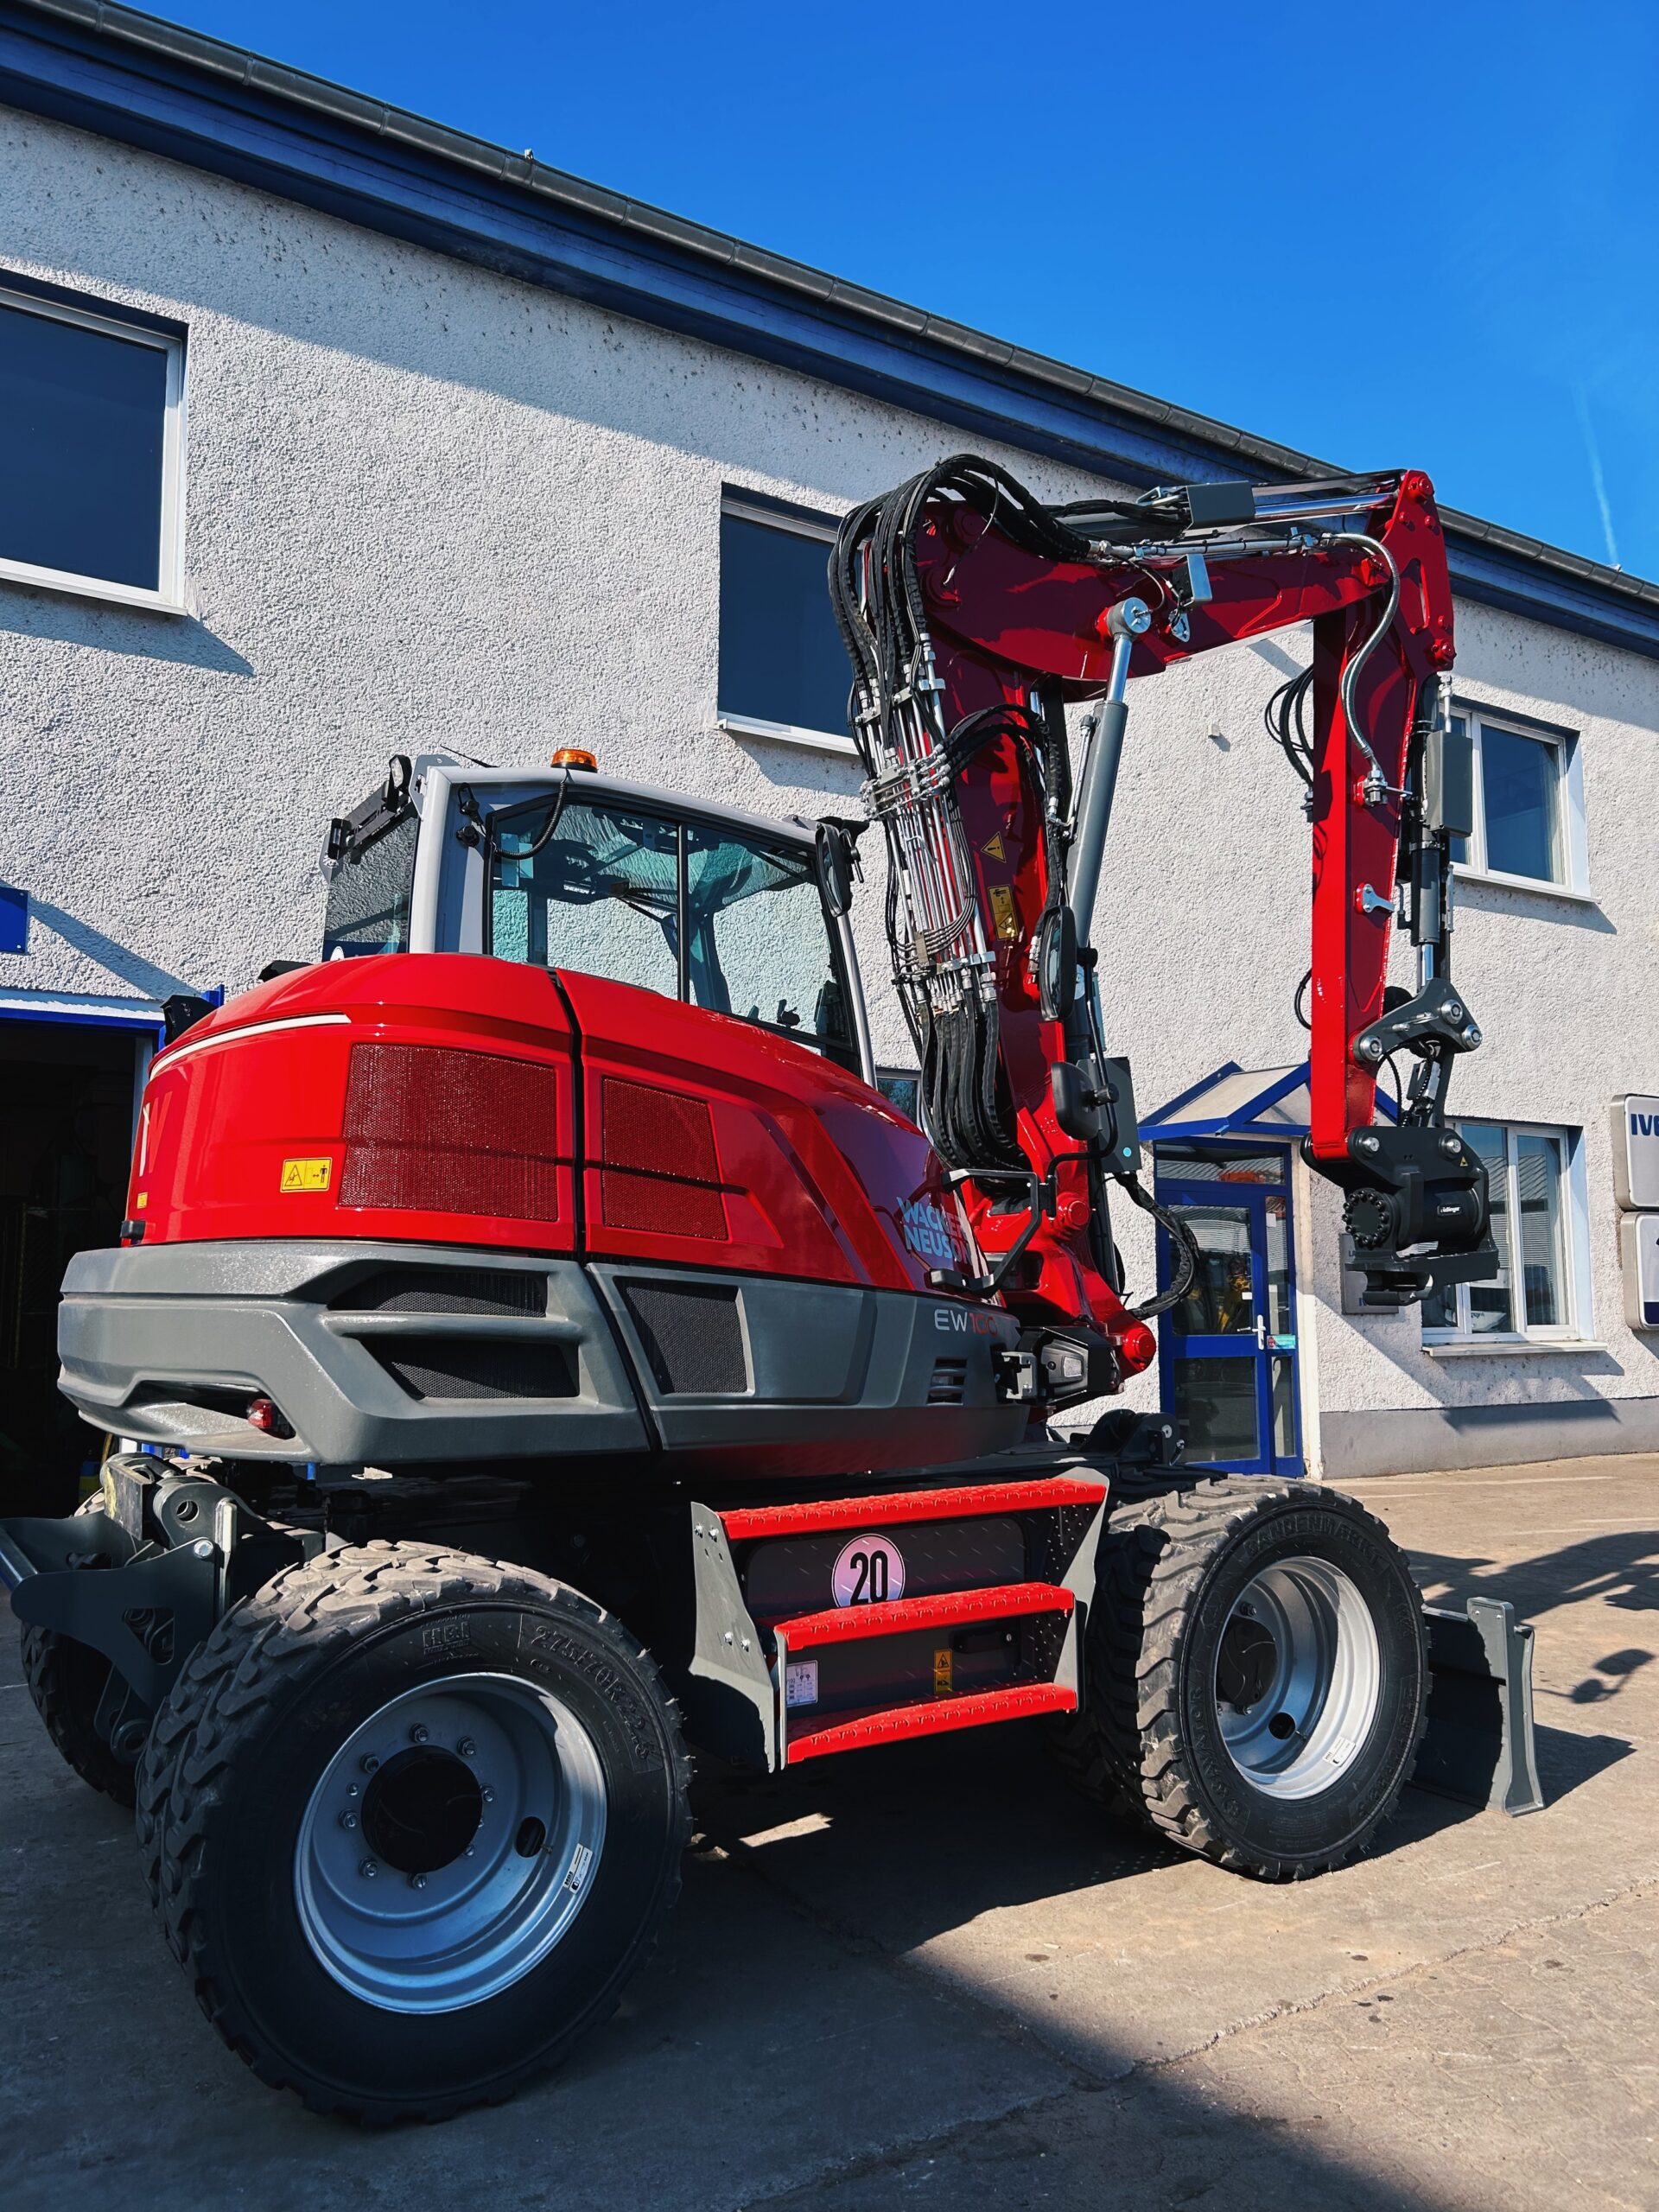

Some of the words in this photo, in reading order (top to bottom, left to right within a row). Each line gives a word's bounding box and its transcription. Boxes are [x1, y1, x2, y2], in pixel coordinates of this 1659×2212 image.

[896, 1196, 967, 1241] WACKER
[904, 1224, 973, 1265] NEUSON
[934, 1308, 998, 1337] EW100
[850, 1550, 888, 1605] 20
